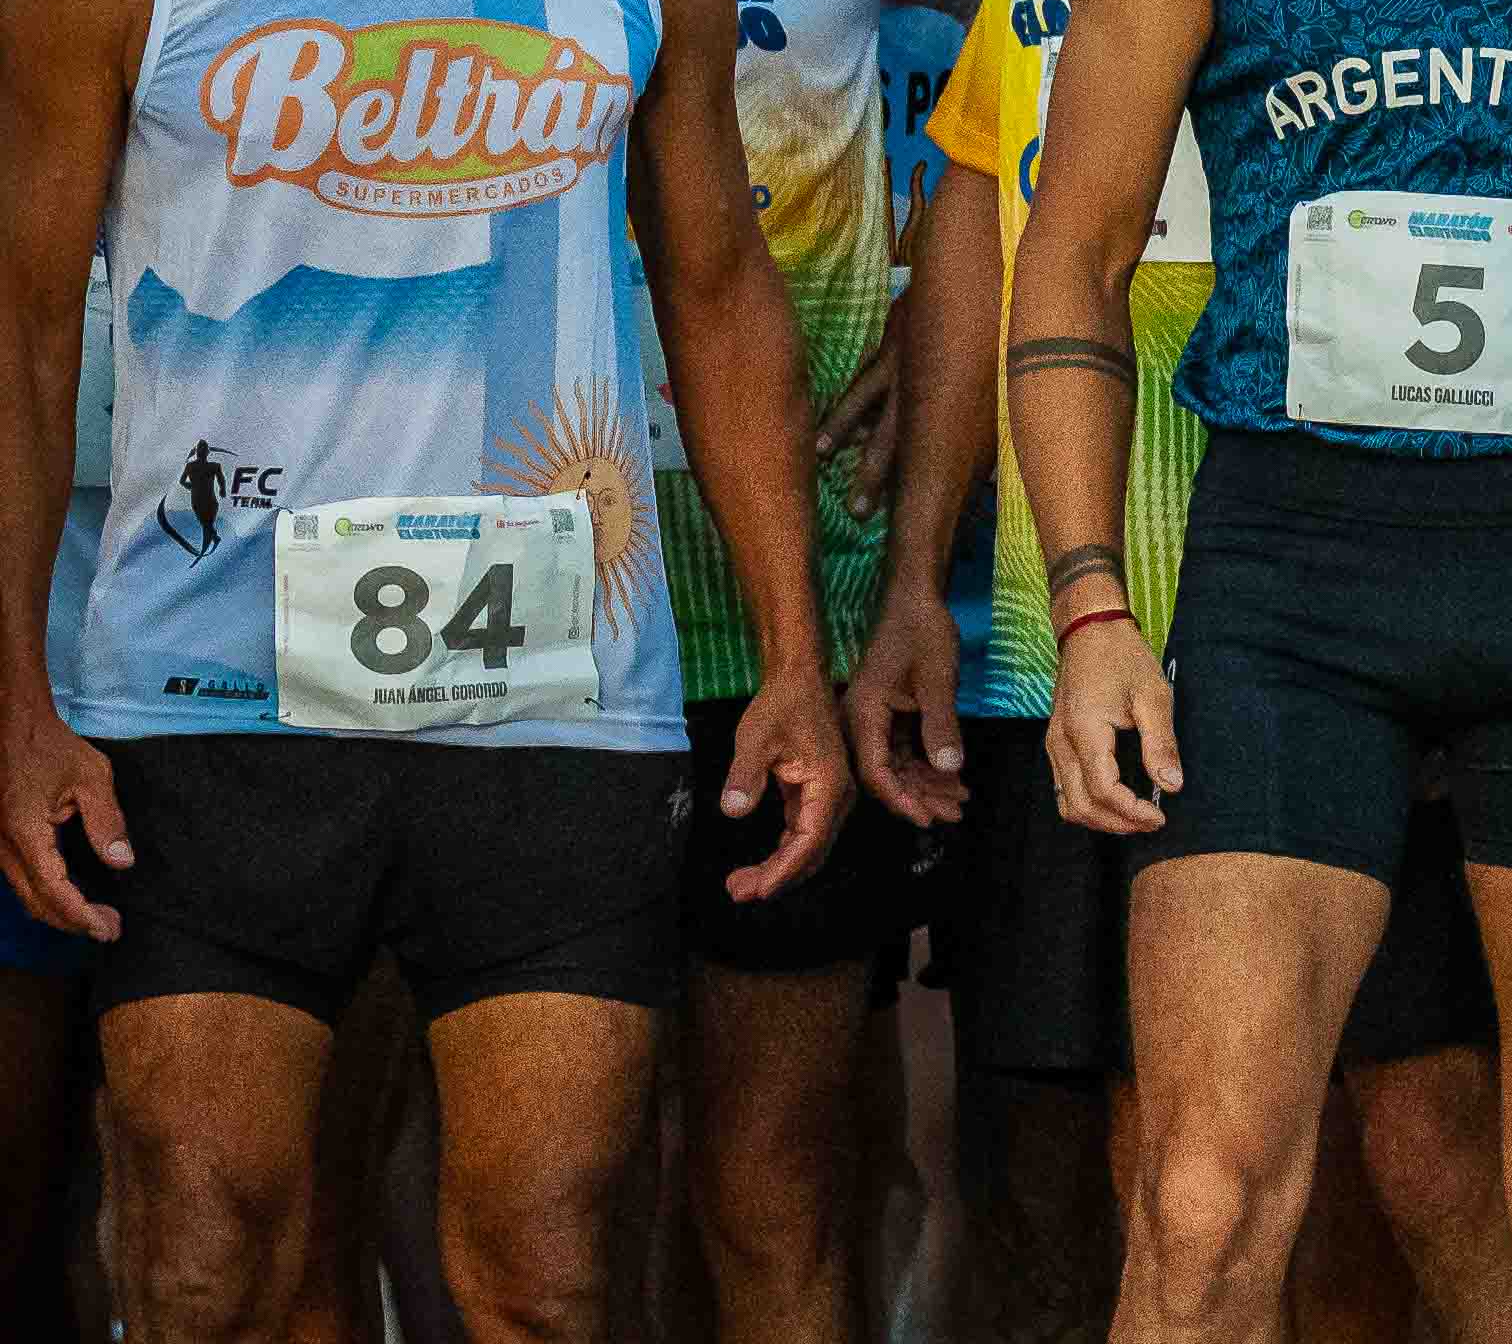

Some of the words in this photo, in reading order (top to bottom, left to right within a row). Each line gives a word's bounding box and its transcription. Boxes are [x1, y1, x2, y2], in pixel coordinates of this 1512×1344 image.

[208, 27, 630, 176] Beltrán
[335, 168, 566, 209] SUPERMERCADOS
[1404, 263, 1486, 375] 5
[1391, 385, 1431, 404] LUCAS
[1434, 387, 1494, 407] GALLUCCI
[231, 467, 283, 497] FC
[350, 563, 526, 675] 84
[372, 687, 406, 705] JUAN
[408, 684, 449, 705] ÁNGEL
